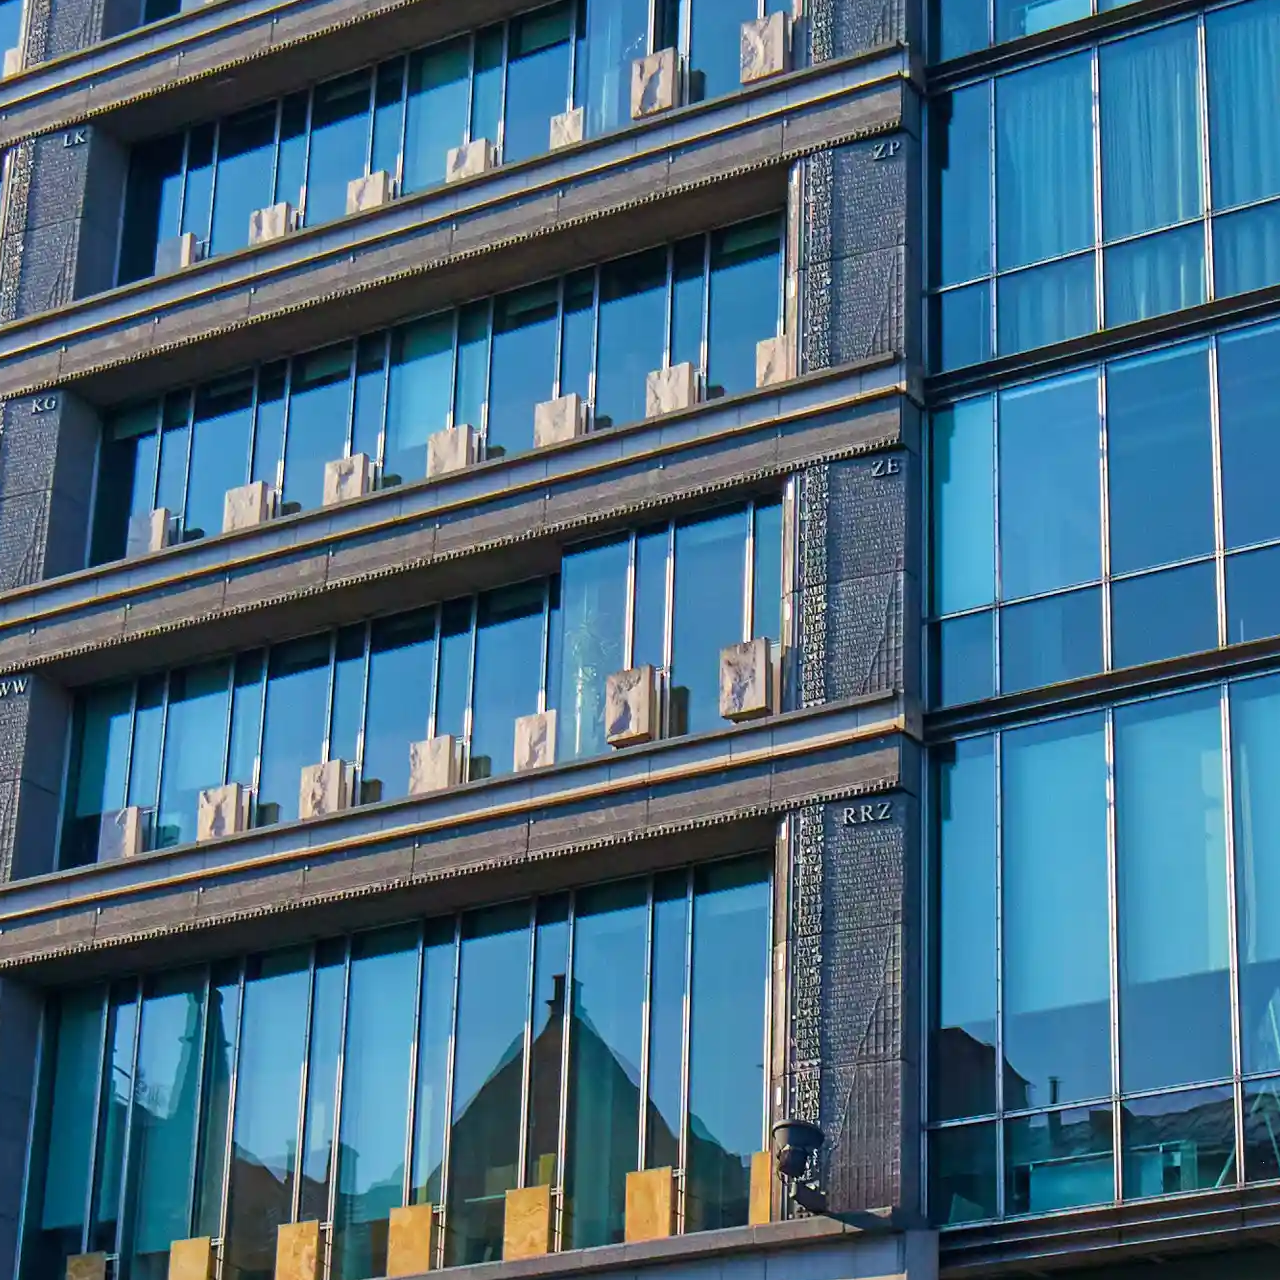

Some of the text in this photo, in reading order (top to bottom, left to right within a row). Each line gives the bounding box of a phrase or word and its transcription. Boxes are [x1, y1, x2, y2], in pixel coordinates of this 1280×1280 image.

[873, 141, 900, 160] ZP
[871, 457, 899, 477] ZE
[843, 802, 892, 824] RRZ
